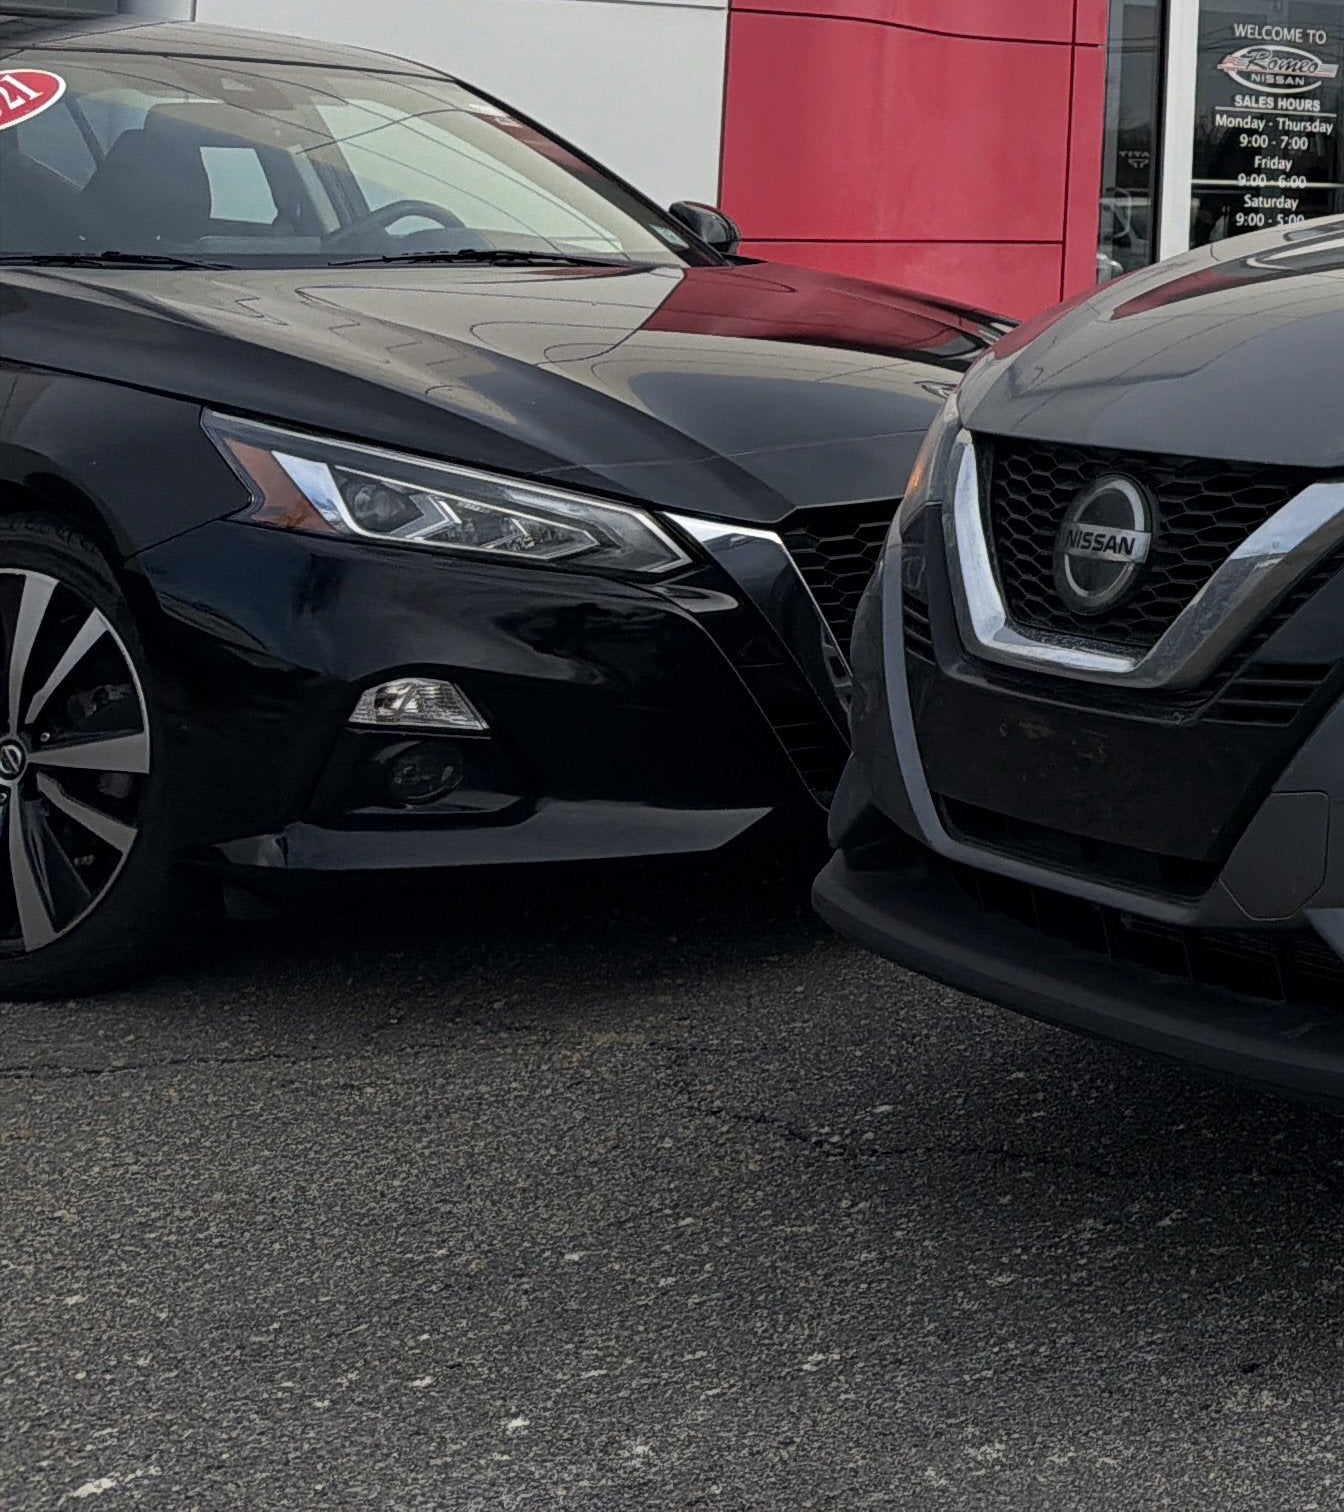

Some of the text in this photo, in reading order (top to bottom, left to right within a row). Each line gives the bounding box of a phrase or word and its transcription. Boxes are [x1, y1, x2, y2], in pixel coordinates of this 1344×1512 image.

[1233, 23, 1327, 45] WELCOME TO
[1244, 48, 1320, 73] Romeo
[1250, 73, 1305, 85] NISSAN
[0, 74, 44, 117] 21
[1233, 94, 1321, 112] SALES HOURS
[1215, 114, 1266, 132] Monday
[1276, 117, 1334, 136] Thursday
[1239, 133, 1269, 148] 9:00
[1280, 136, 1309, 150] 7:00
[1254, 155, 1293, 172] Friday
[1238, 173, 1267, 187] 9:00
[1243, 194, 1299, 211] Saturday
[1236, 213, 1265, 226] 9:00
[1065, 530, 1135, 556] NISSAN
